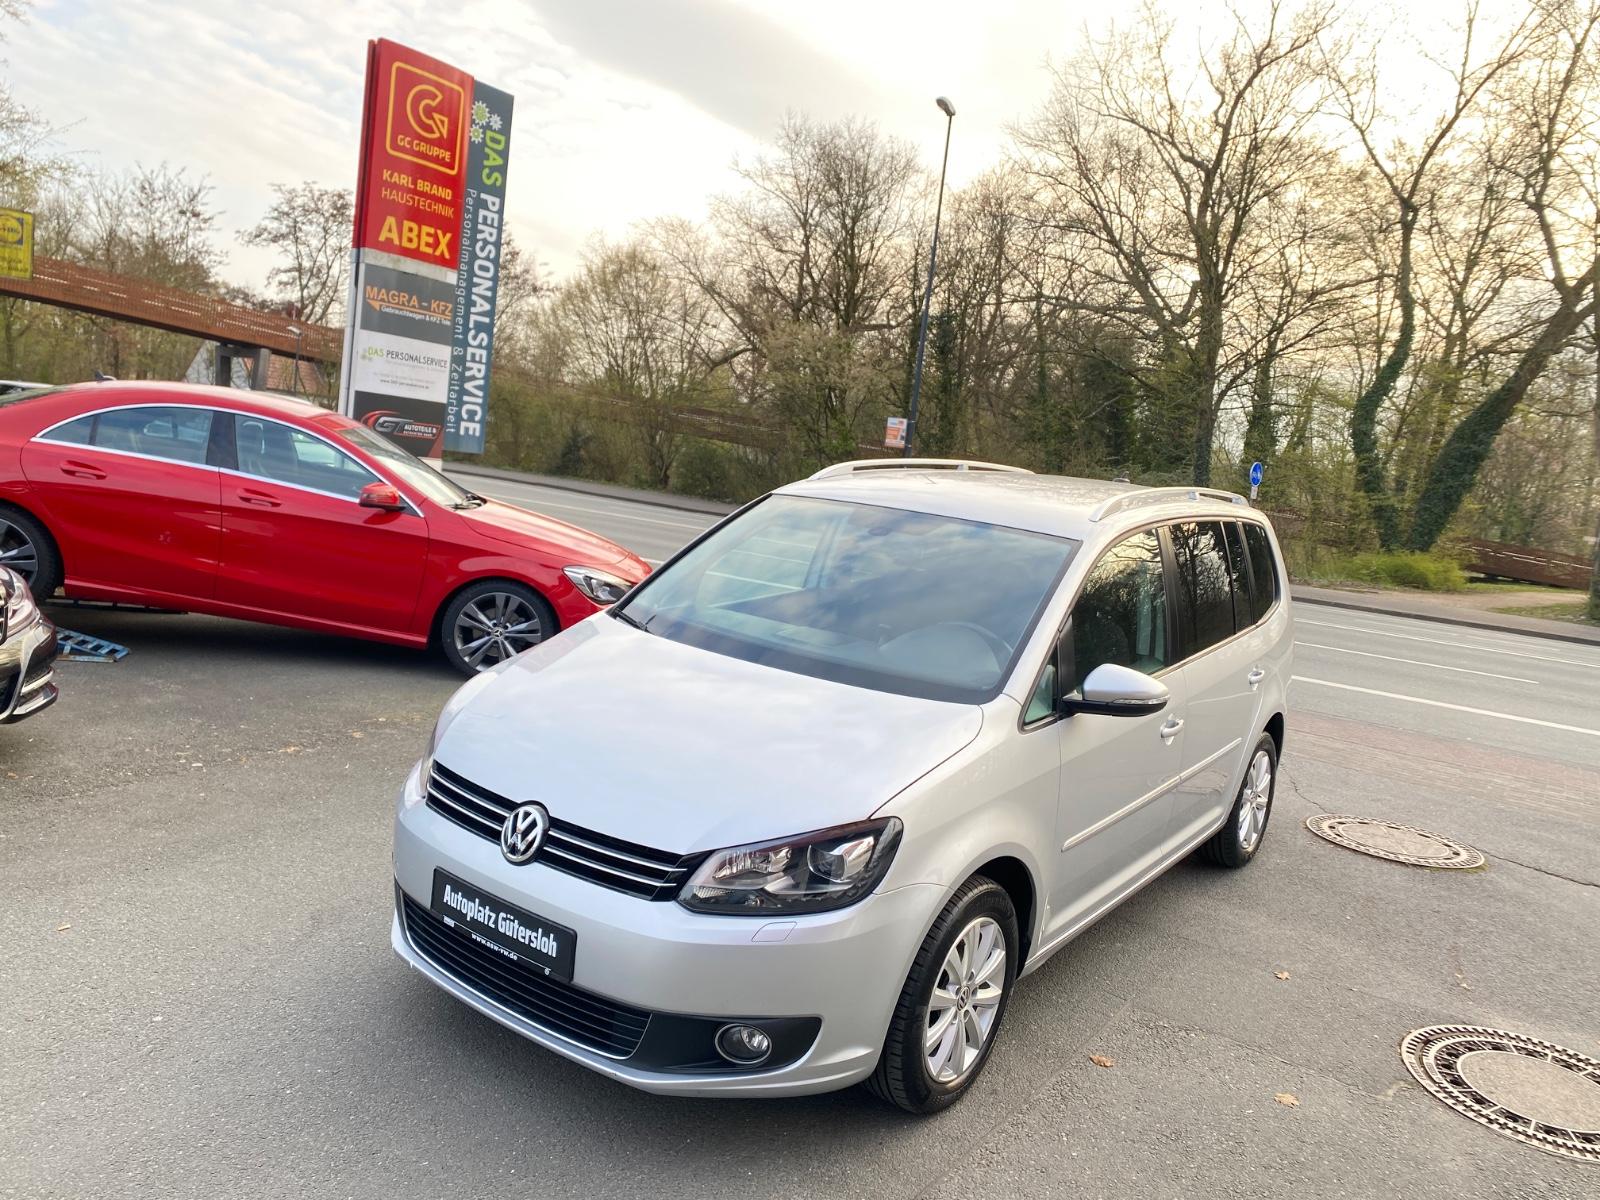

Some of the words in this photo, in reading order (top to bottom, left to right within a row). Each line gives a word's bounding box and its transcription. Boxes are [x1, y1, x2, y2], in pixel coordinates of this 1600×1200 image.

[397, 134, 411, 149] GC
[412, 139, 451, 162] GRUPPE
[481, 130, 506, 187] DAS
[381, 187, 455, 219] HAUSTECHNIK
[383, 169, 414, 188] KARL
[416, 178, 452, 201] BRAND
[378, 215, 453, 259] ABEX
[454, 188, 477, 339] Personalmanagement
[365, 285, 418, 308] MAGRA
[430, 299, 453, 316] KFZ
[459, 193, 500, 437] PERSONALSERVICE
[368, 347, 385, 357] DAS
[386, 349, 448, 369] PERSONALSERVICE
[452, 347, 464, 355] &
[445, 363, 463, 432] Zeitarbeit
[443, 884, 496, 929] Autoplatz
[497, 911, 557, 958] Gütersloh
